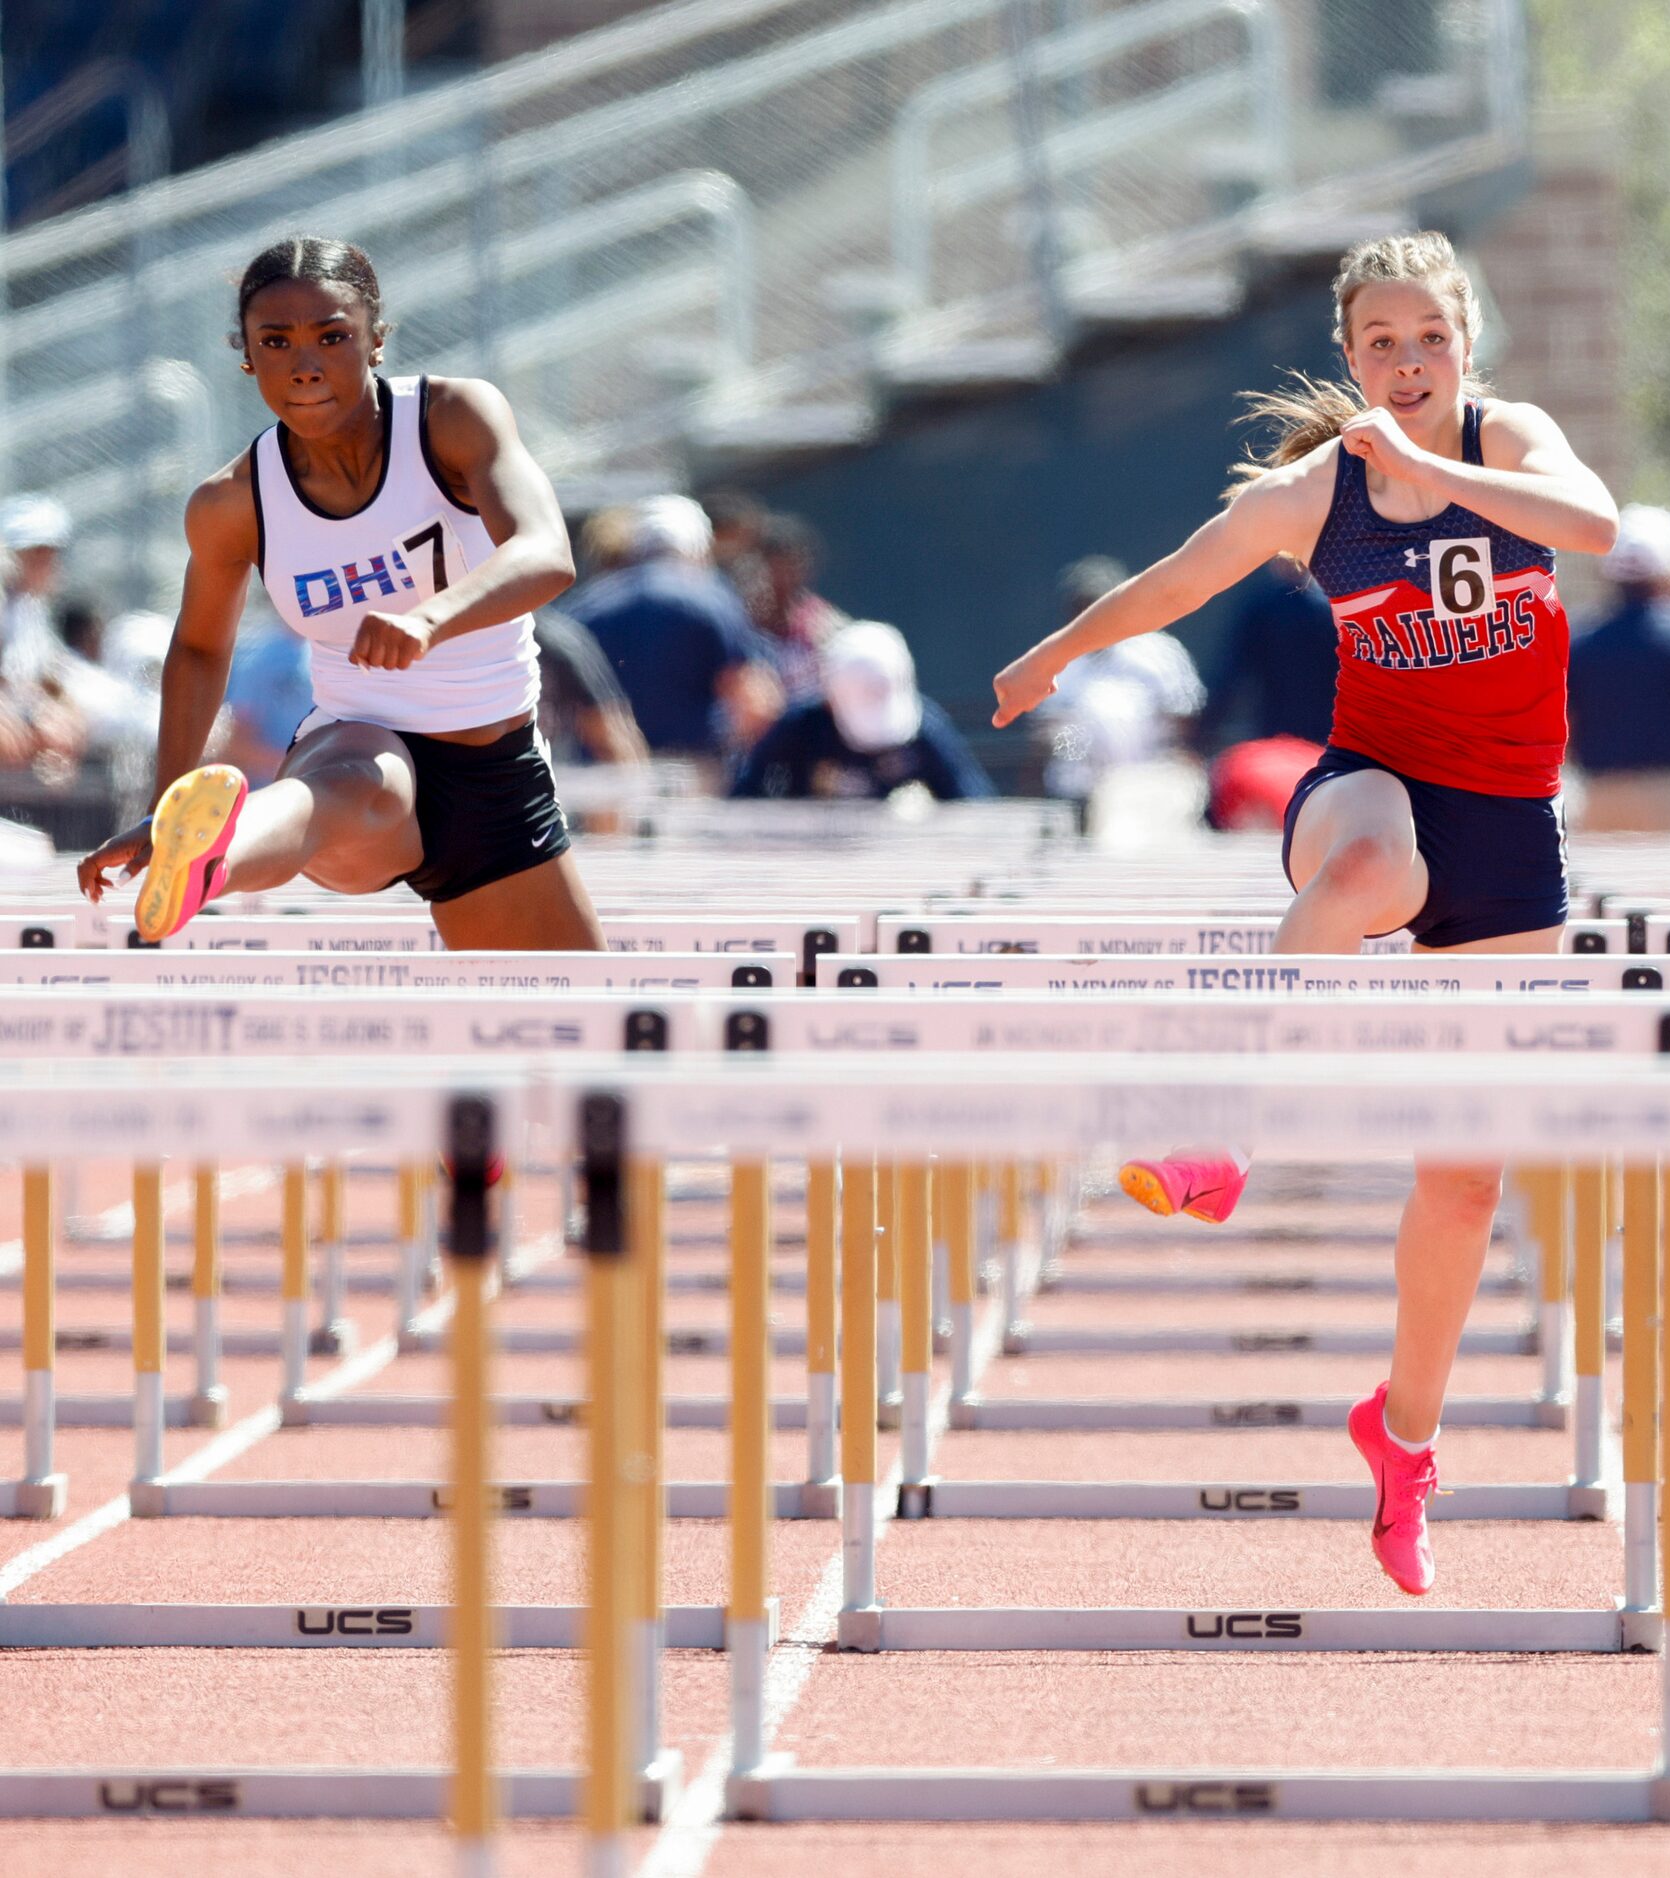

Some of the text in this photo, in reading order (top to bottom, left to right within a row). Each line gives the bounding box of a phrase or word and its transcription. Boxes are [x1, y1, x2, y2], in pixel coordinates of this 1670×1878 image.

[402, 521, 447, 594] 7
[1438, 545, 1486, 614] 6
[1339, 589, 1536, 670] RAIDERS
[1187, 968, 1300, 992] JESUIT
[1369, 980, 1430, 993] ELKINS
[91, 1002, 239, 1055] JESUIT
[470, 1020, 586, 1049] UCS
[1504, 1022, 1618, 1050] UCS
[1200, 1490, 1300, 1512] UCS
[297, 1608, 414, 1636] UCS
[1186, 1612, 1303, 1639] UCS
[100, 1779, 240, 1811] UCS
[1131, 1781, 1276, 1812] UCS
